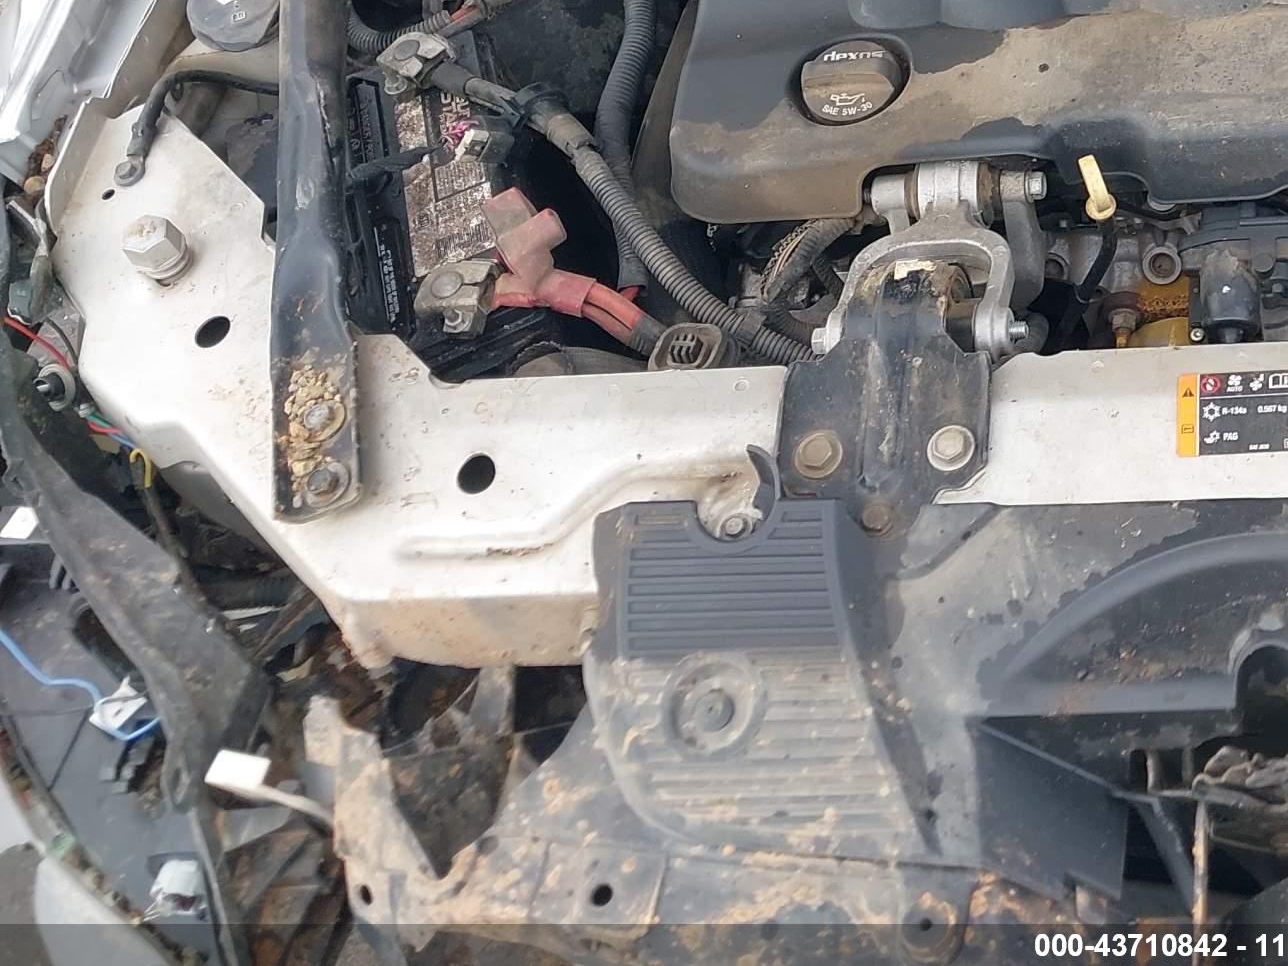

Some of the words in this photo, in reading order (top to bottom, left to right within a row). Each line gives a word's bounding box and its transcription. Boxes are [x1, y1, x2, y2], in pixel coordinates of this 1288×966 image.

[821, 104, 839, 115] SAE
[842, 101, 873, 116] 5W-30
[1223, 432, 1239, 442] PAG
